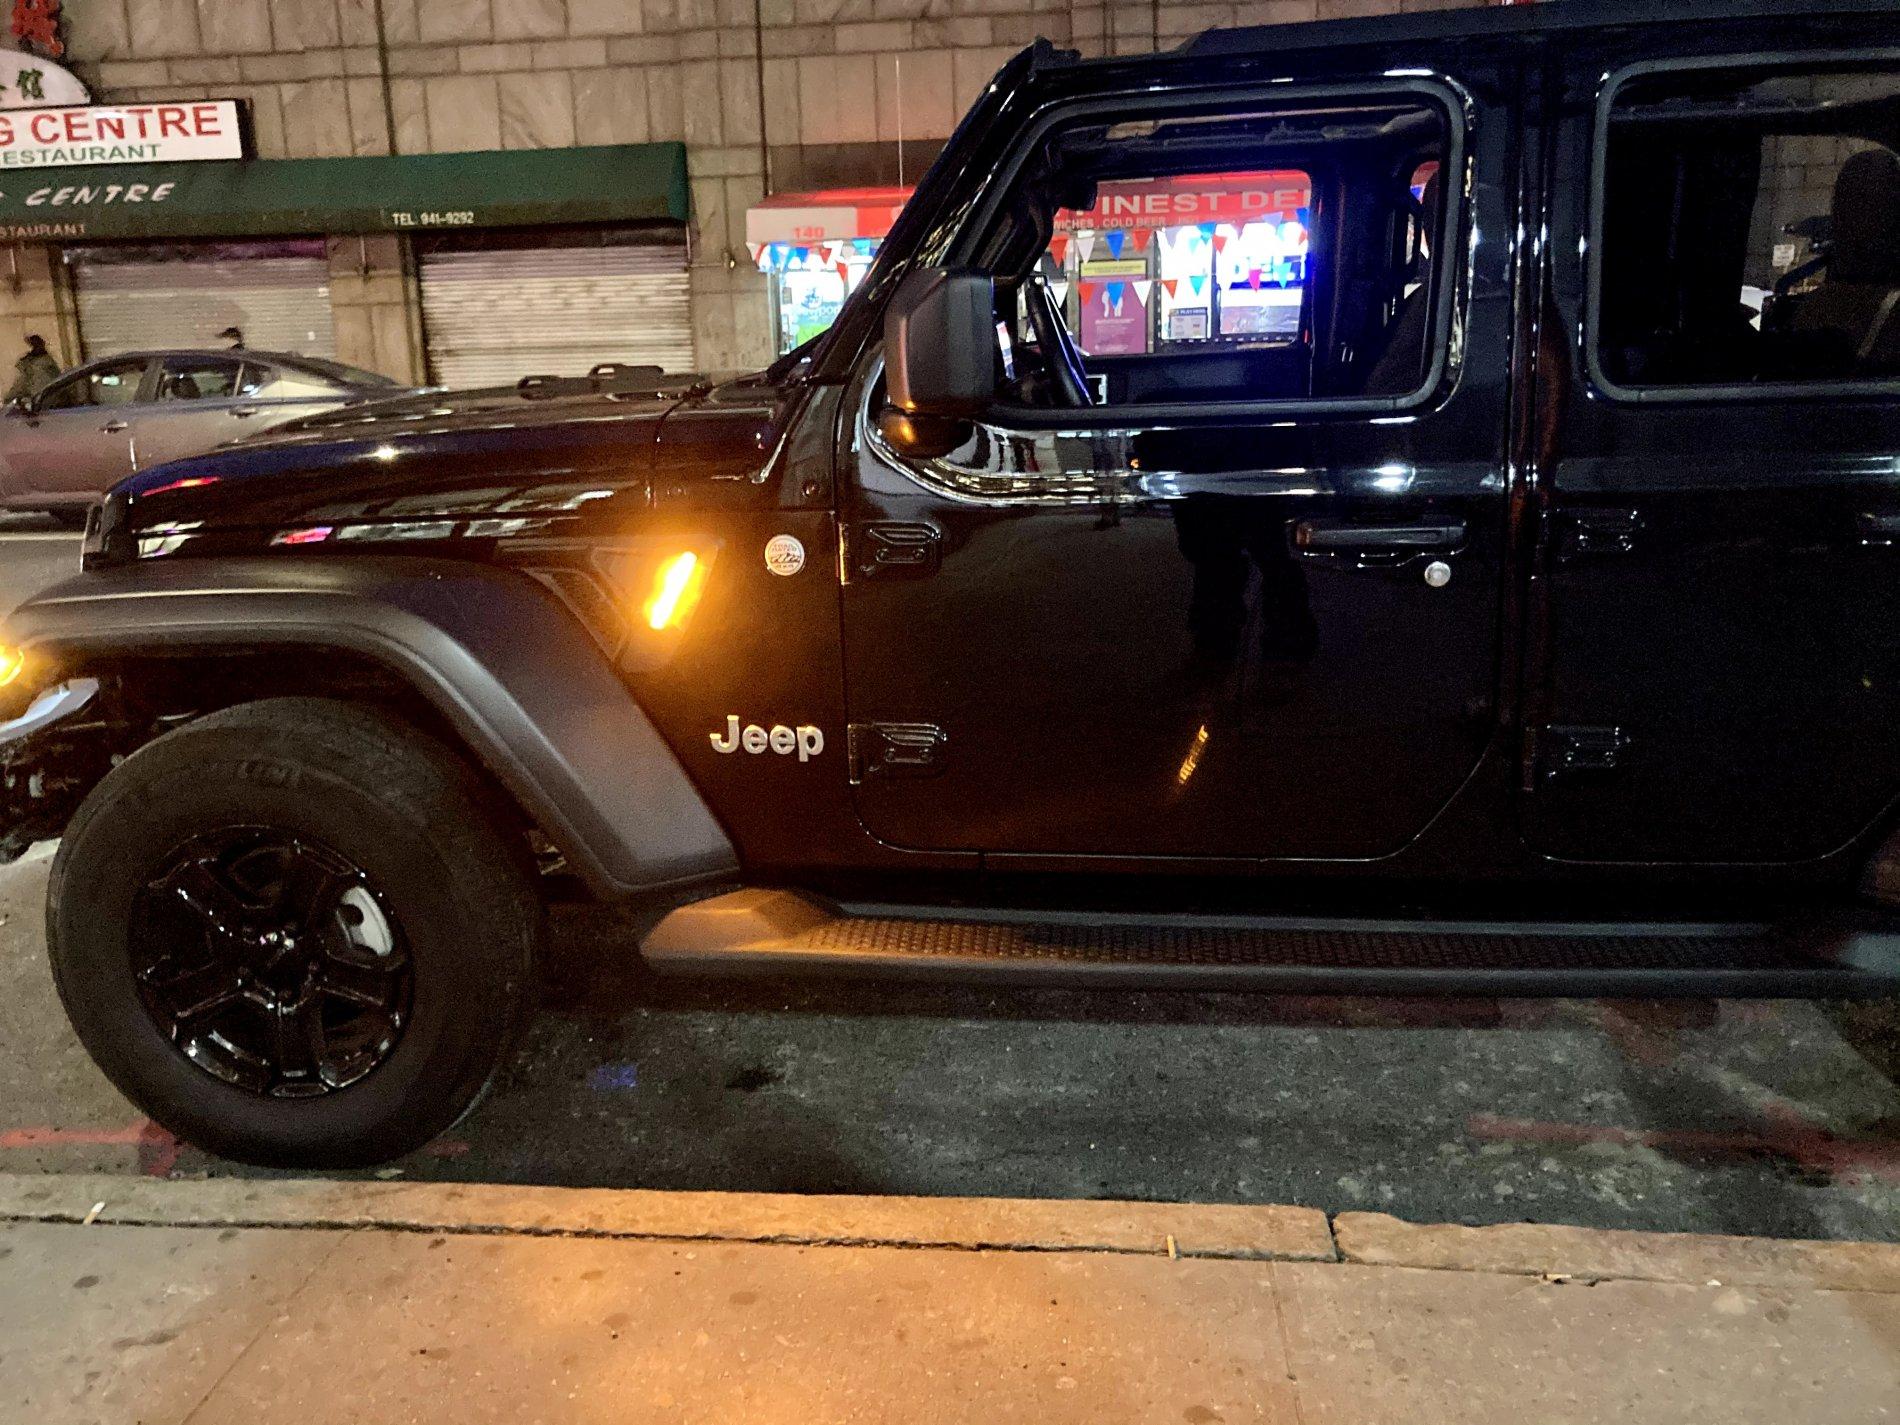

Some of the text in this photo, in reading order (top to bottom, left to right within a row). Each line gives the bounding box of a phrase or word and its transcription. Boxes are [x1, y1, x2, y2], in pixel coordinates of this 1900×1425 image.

[31, 105, 222, 145] CENTRE
[2, 143, 162, 166] ESTAURANT
[25, 181, 176, 207] CENTRE
[1077, 189, 1228, 216] INEST
[1102, 216, 1134, 229] COLD
[709, 714, 825, 763] Jeep
